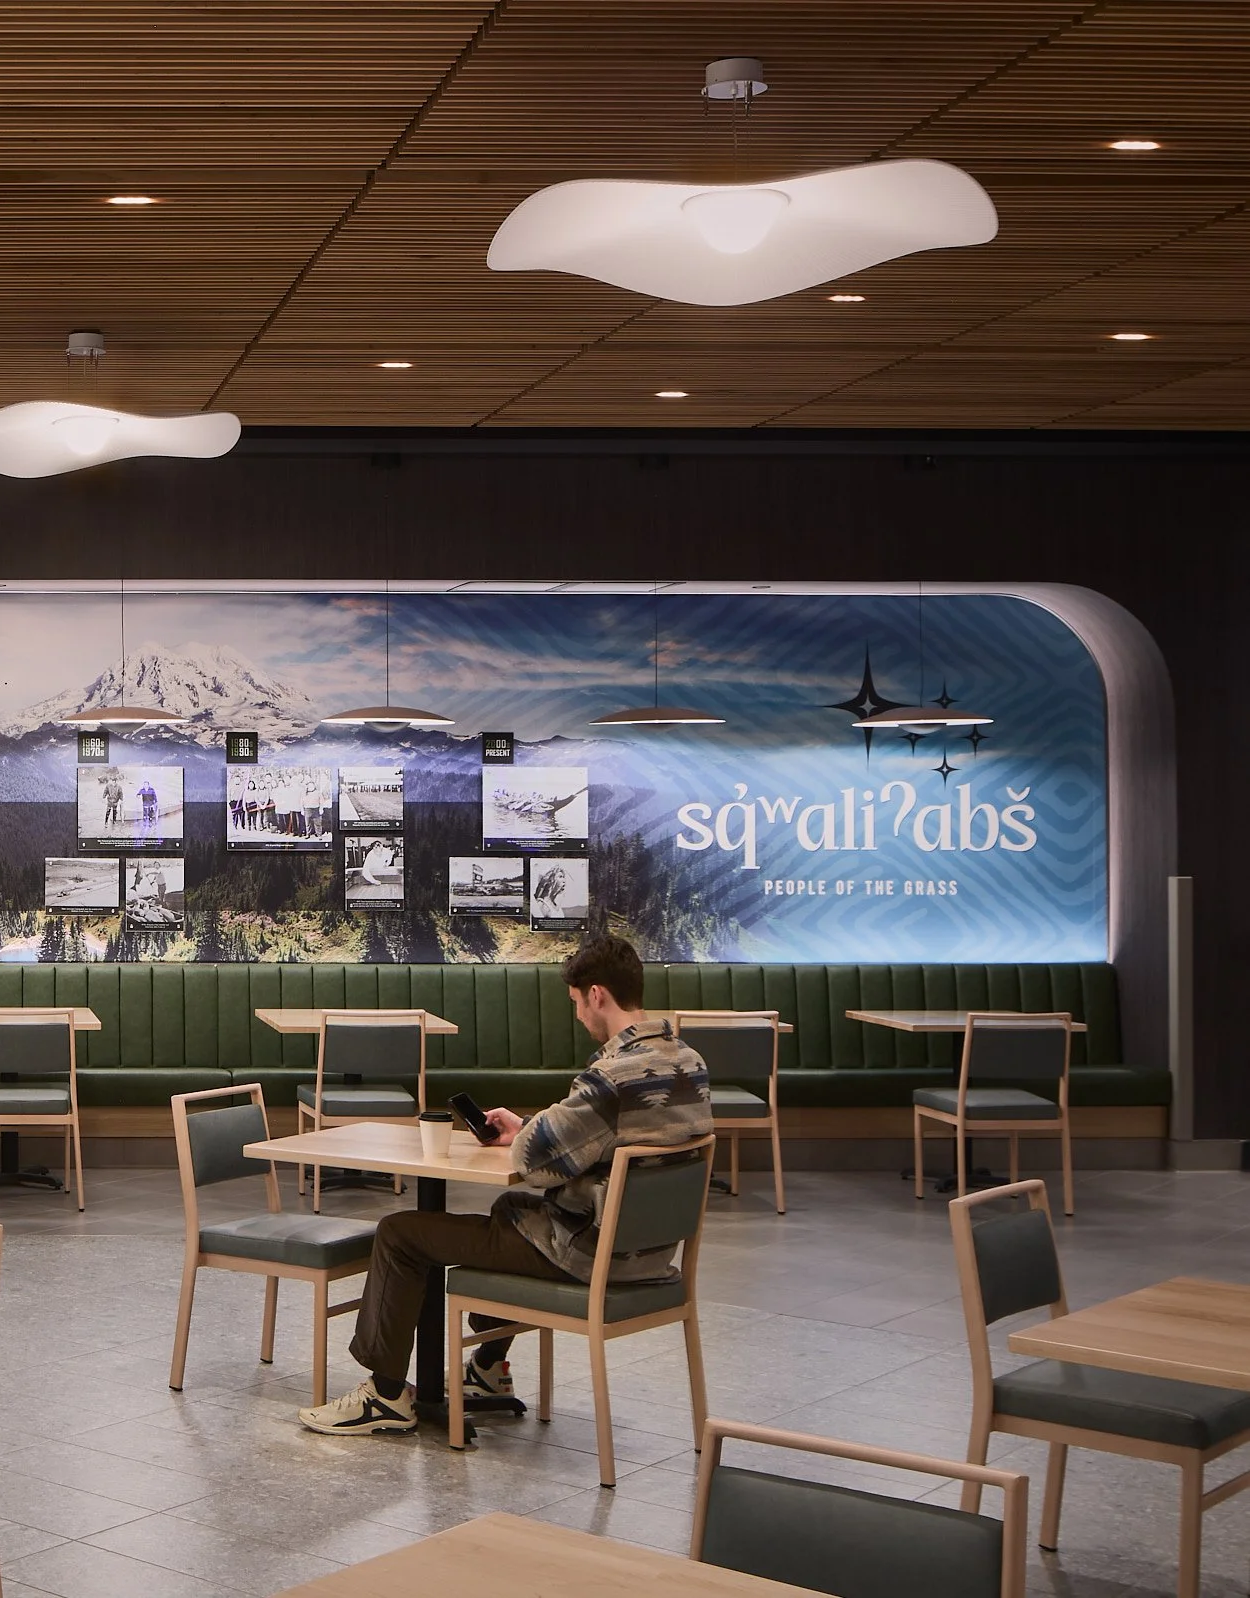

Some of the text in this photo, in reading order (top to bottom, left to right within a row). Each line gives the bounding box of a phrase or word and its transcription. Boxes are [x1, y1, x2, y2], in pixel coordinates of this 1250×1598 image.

[82, 738, 105, 747] 1960s
[82, 747, 105, 757] 1970s
[485, 748, 510, 757] PRESENT
[764, 880, 958, 896] PEOPLE OF THE GRASS
